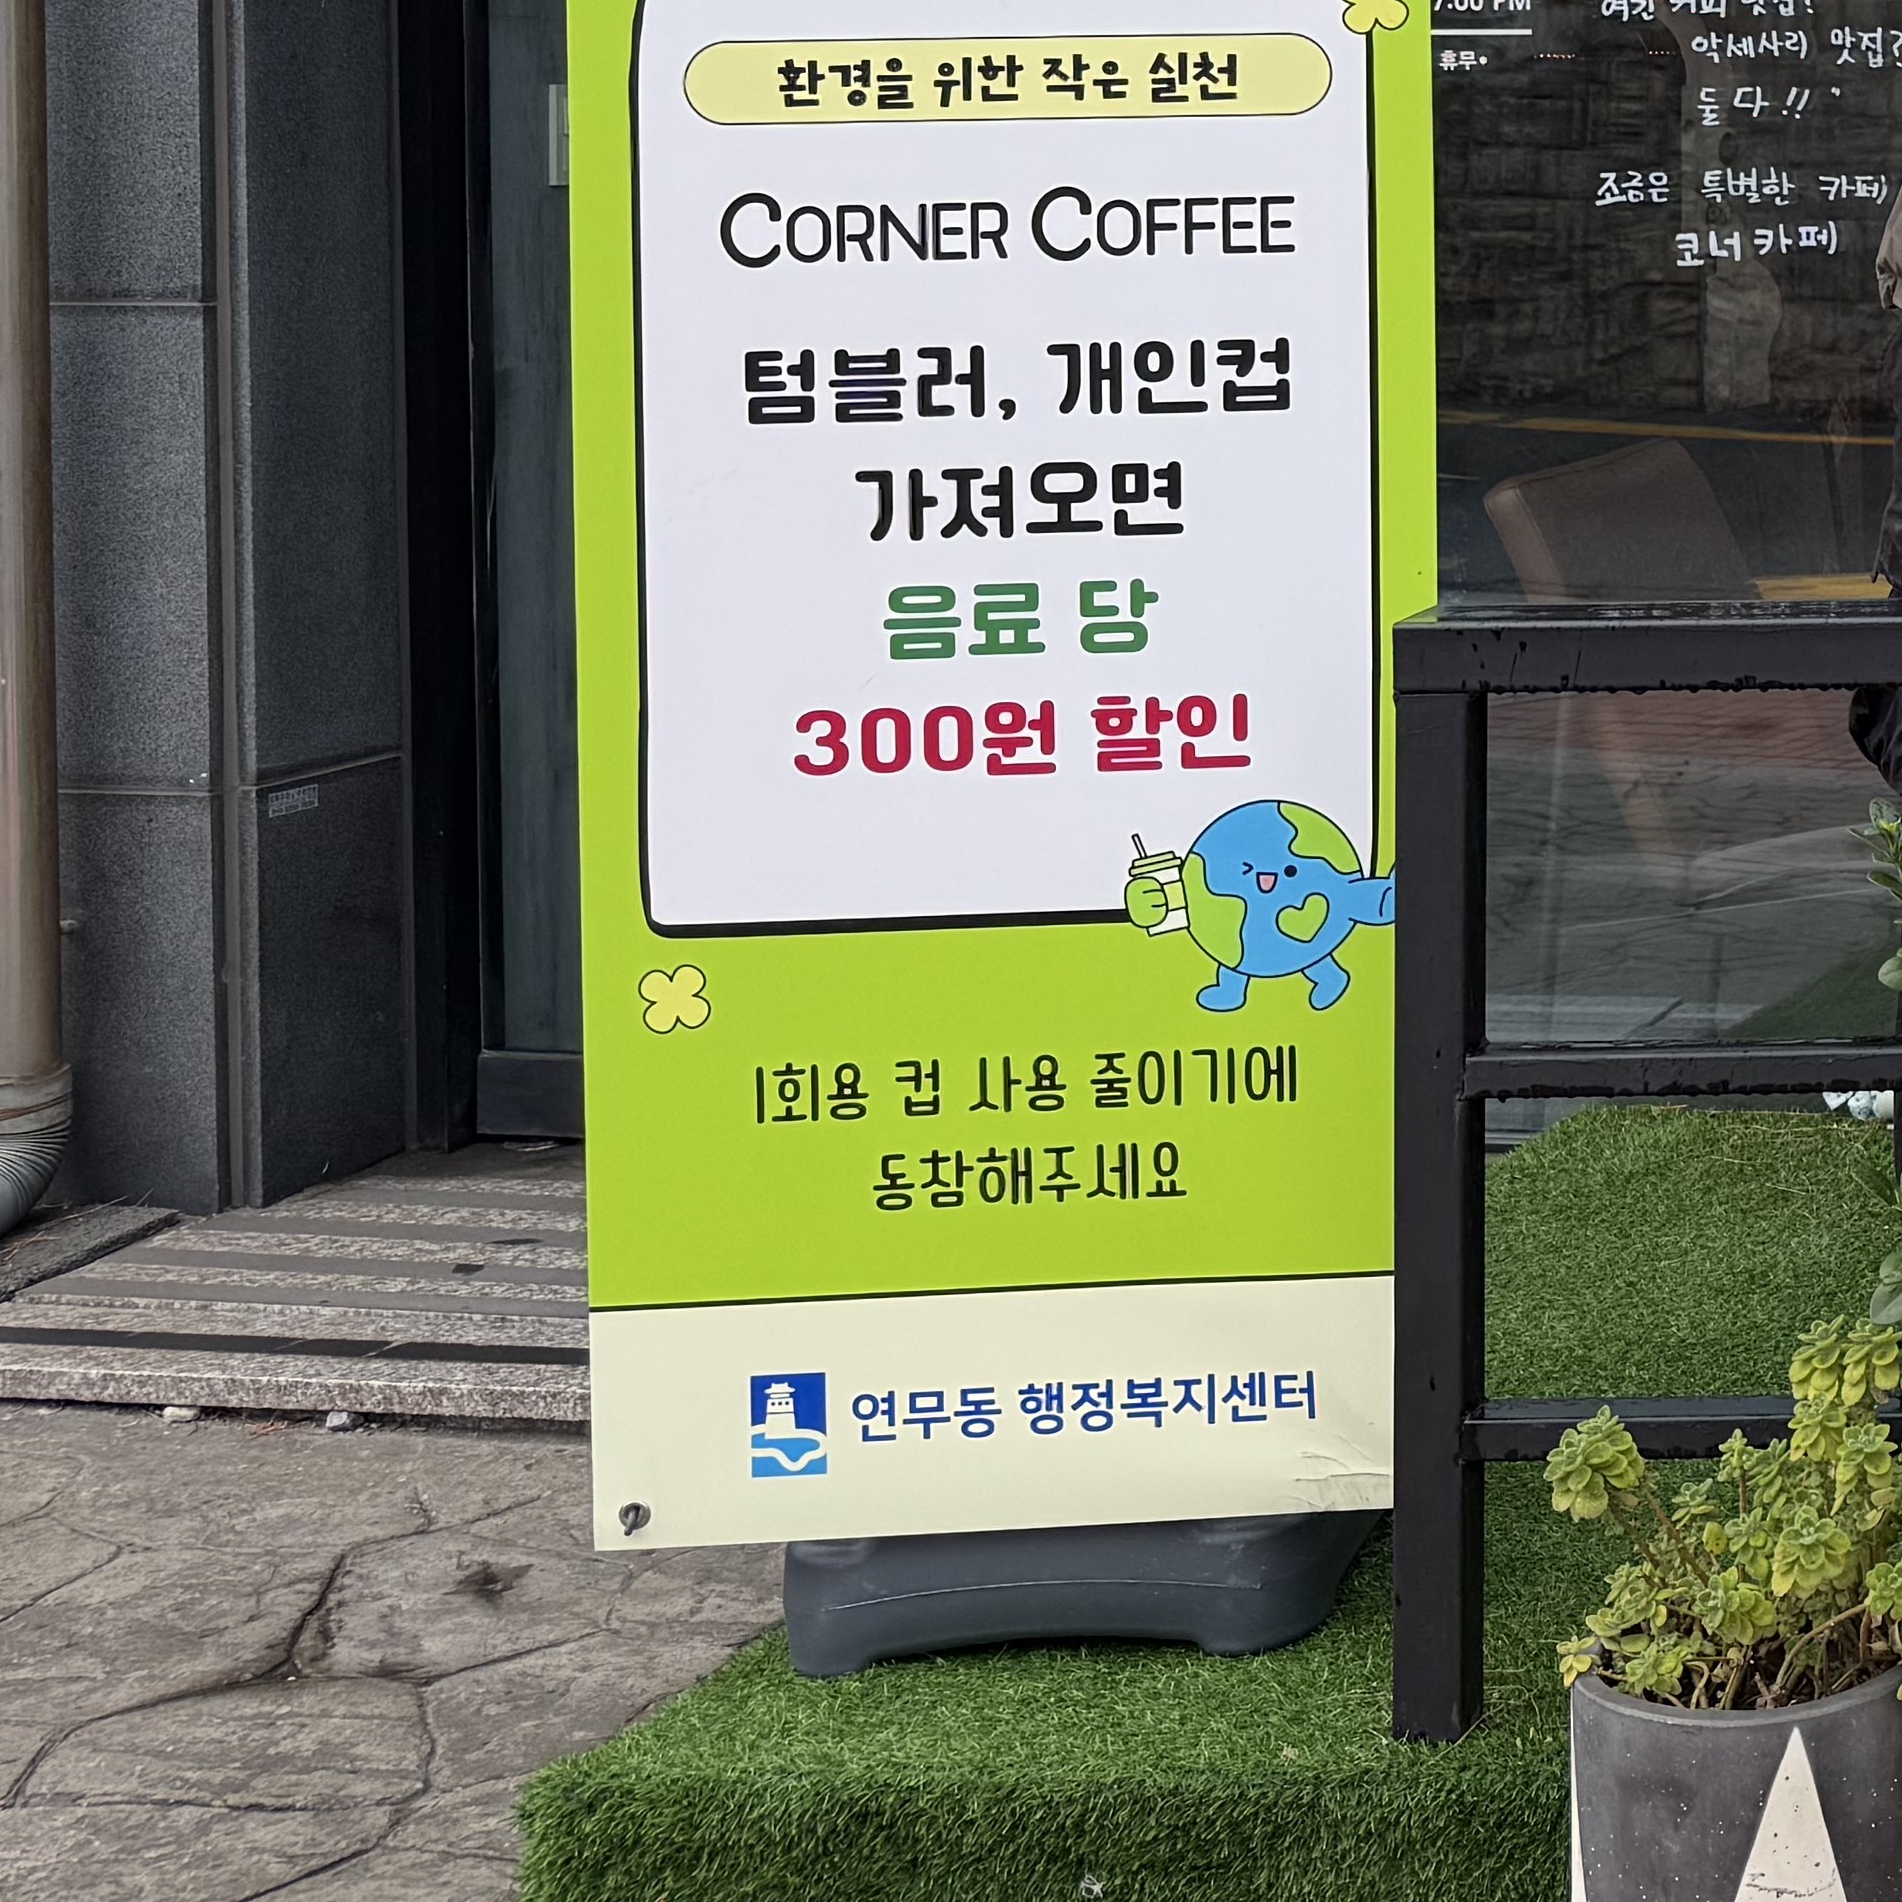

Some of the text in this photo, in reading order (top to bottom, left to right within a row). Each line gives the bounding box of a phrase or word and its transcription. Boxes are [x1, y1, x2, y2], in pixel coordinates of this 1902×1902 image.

[776, 52, 1240, 110] 환경을 위한 작은 실천
[1691, 30, 1808, 64] 악세사리
[1594, 167, 1889, 207] 조금은 특별한 카페
[743, 337, 1293, 426] 텀블러, 개인컵
[854, 460, 1186, 542] 가져오면
[882, 578, 1160, 661] 음료 당
[792, 693, 1252, 778] 300원 할인
[754, 1045, 1298, 1126] 1회용 컵 사용 줄이기에
[871, 1140, 1189, 1212] 동참해주세요
[850, 1368, 1318, 1443] 연무동 행정복지센터
